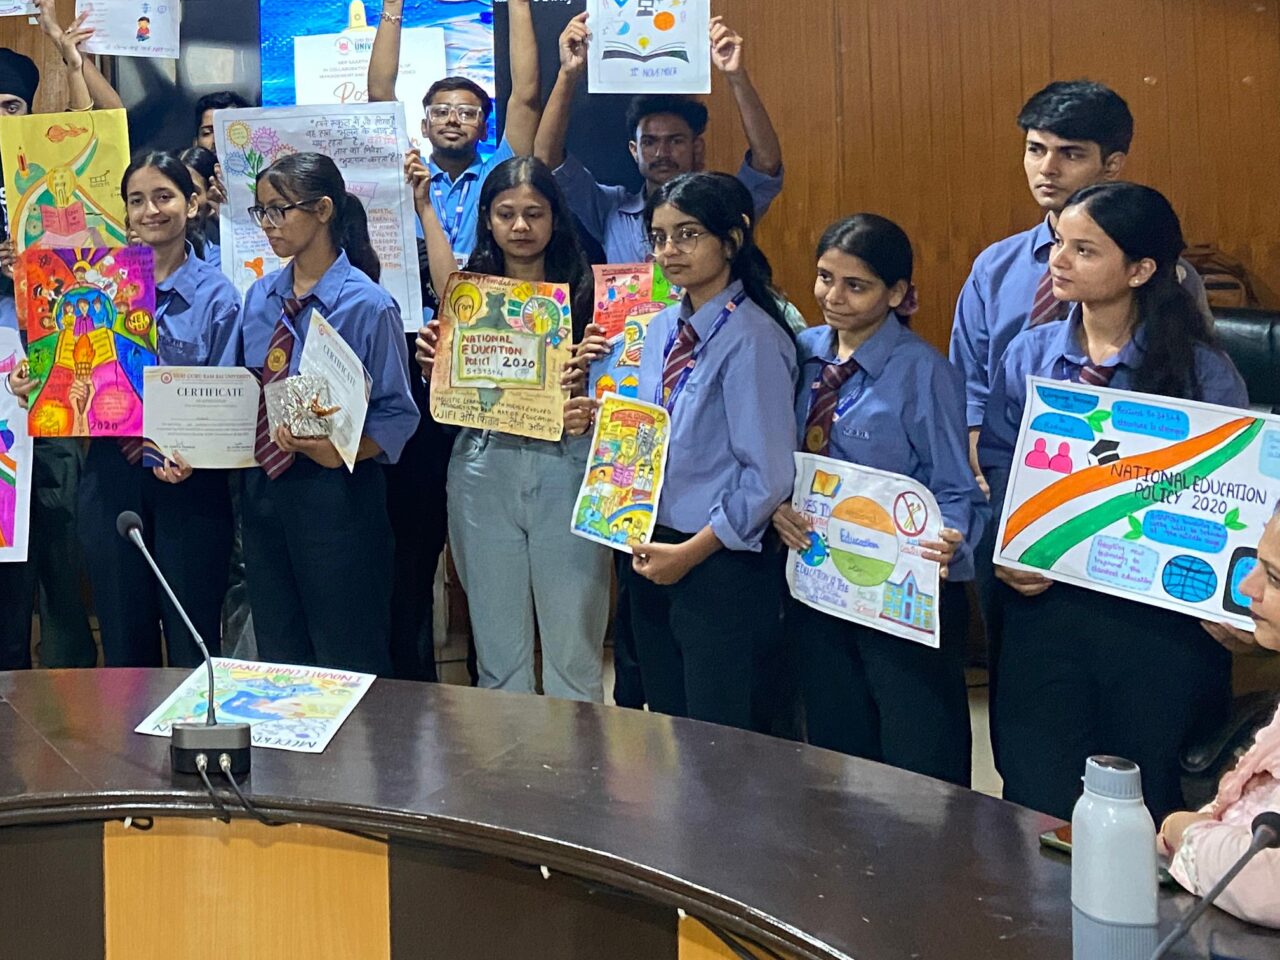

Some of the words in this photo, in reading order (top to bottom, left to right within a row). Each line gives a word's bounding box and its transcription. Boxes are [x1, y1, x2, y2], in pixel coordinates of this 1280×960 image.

[642, 67, 678, 78] NOVEMBER
[333, 82, 369, 104] Pos
[462, 334, 513, 344] NATIONAL
[461, 344, 522, 356] EDUCATION
[323, 343, 357, 387] CERTIFICATE
[502, 356, 535, 369] 2020
[177, 387, 244, 397] CERTIFICATE
[434, 406, 456, 420] WIFI
[90, 421, 118, 431] 2020
[1111, 464, 1190, 490] NATIONAL
[1193, 476, 1267, 505] EDUCATION
[1134, 483, 1182, 504] POLICY
[1192, 495, 1228, 514] 2020
[840, 528, 880, 549] Education
